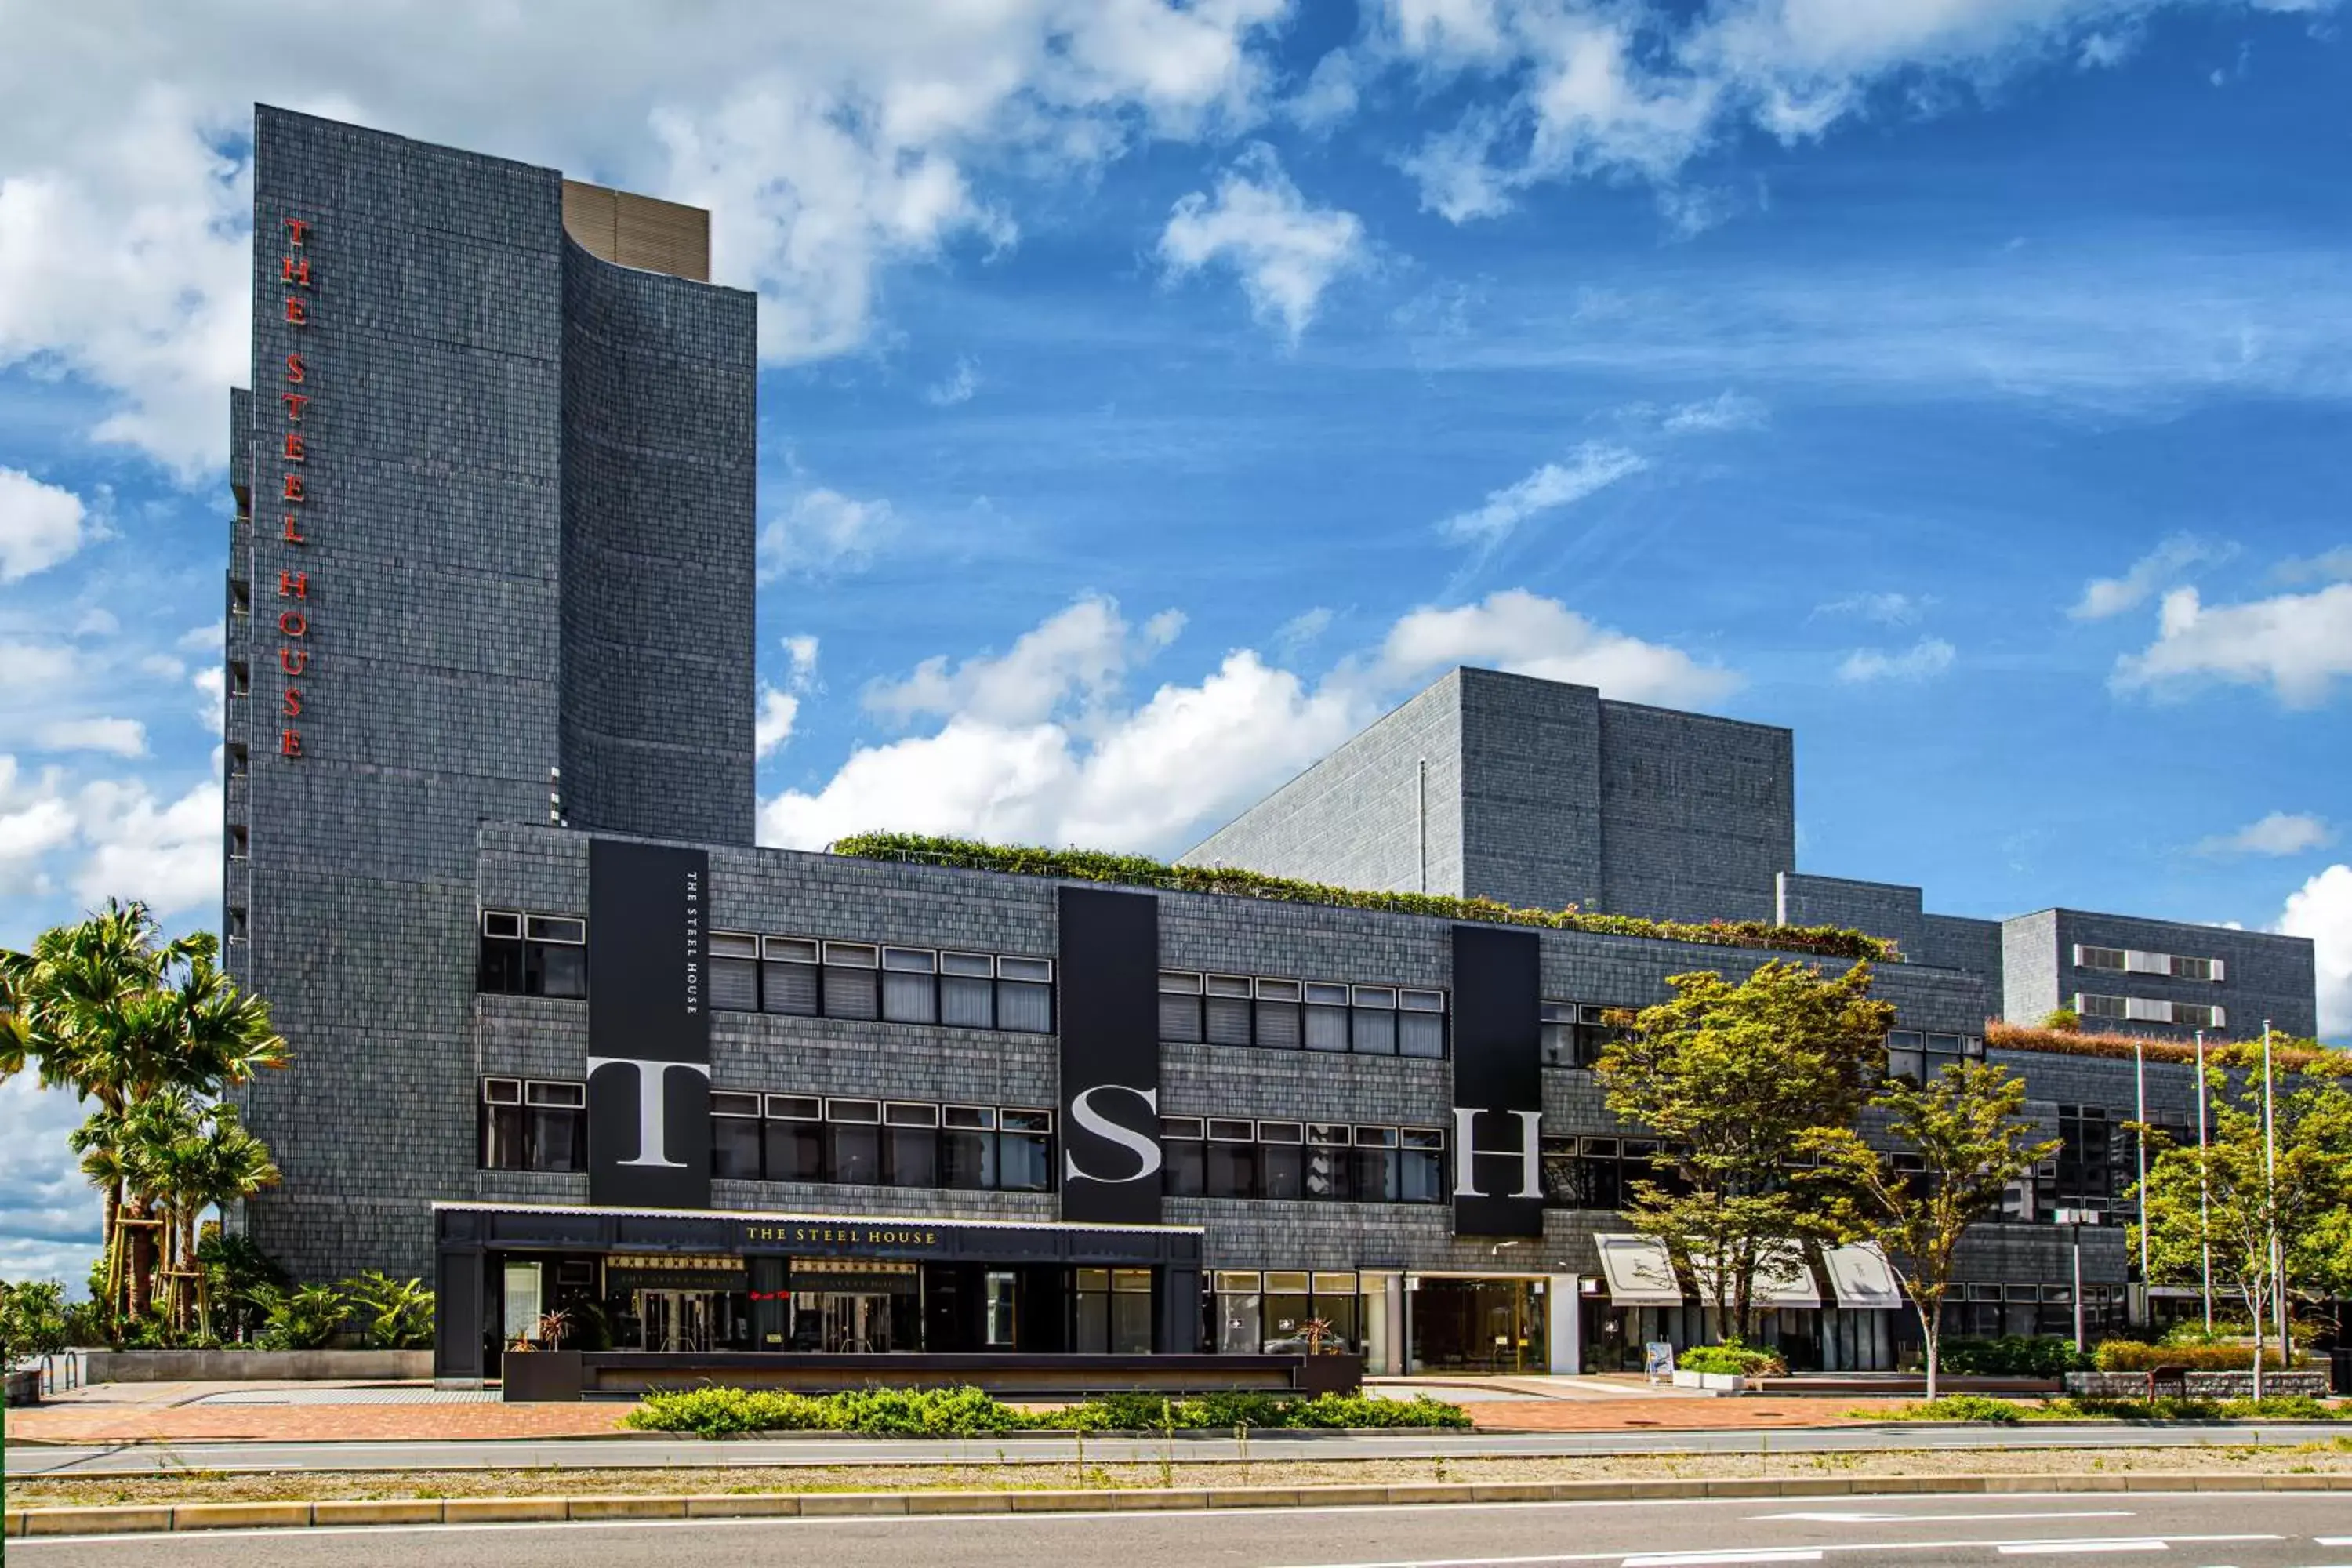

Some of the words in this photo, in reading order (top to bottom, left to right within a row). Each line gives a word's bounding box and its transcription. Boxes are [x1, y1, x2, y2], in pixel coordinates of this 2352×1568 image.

[281, 218, 310, 325] THE
[282, 353, 309, 541] STEEL
[278, 569, 308, 757] HOUSE
[687, 871, 697, 901] THE
[687, 908, 697, 956] STEEL
[687, 963, 697, 1014] HOUSE
[586, 1056, 711, 1168] T
[1065, 1084, 1162, 1184] S
[1453, 1107, 1544, 1199] H
[746, 1227, 786, 1240] THE
[796, 1228, 860, 1243] STEEL
[869, 1231, 936, 1245] HOUSE
